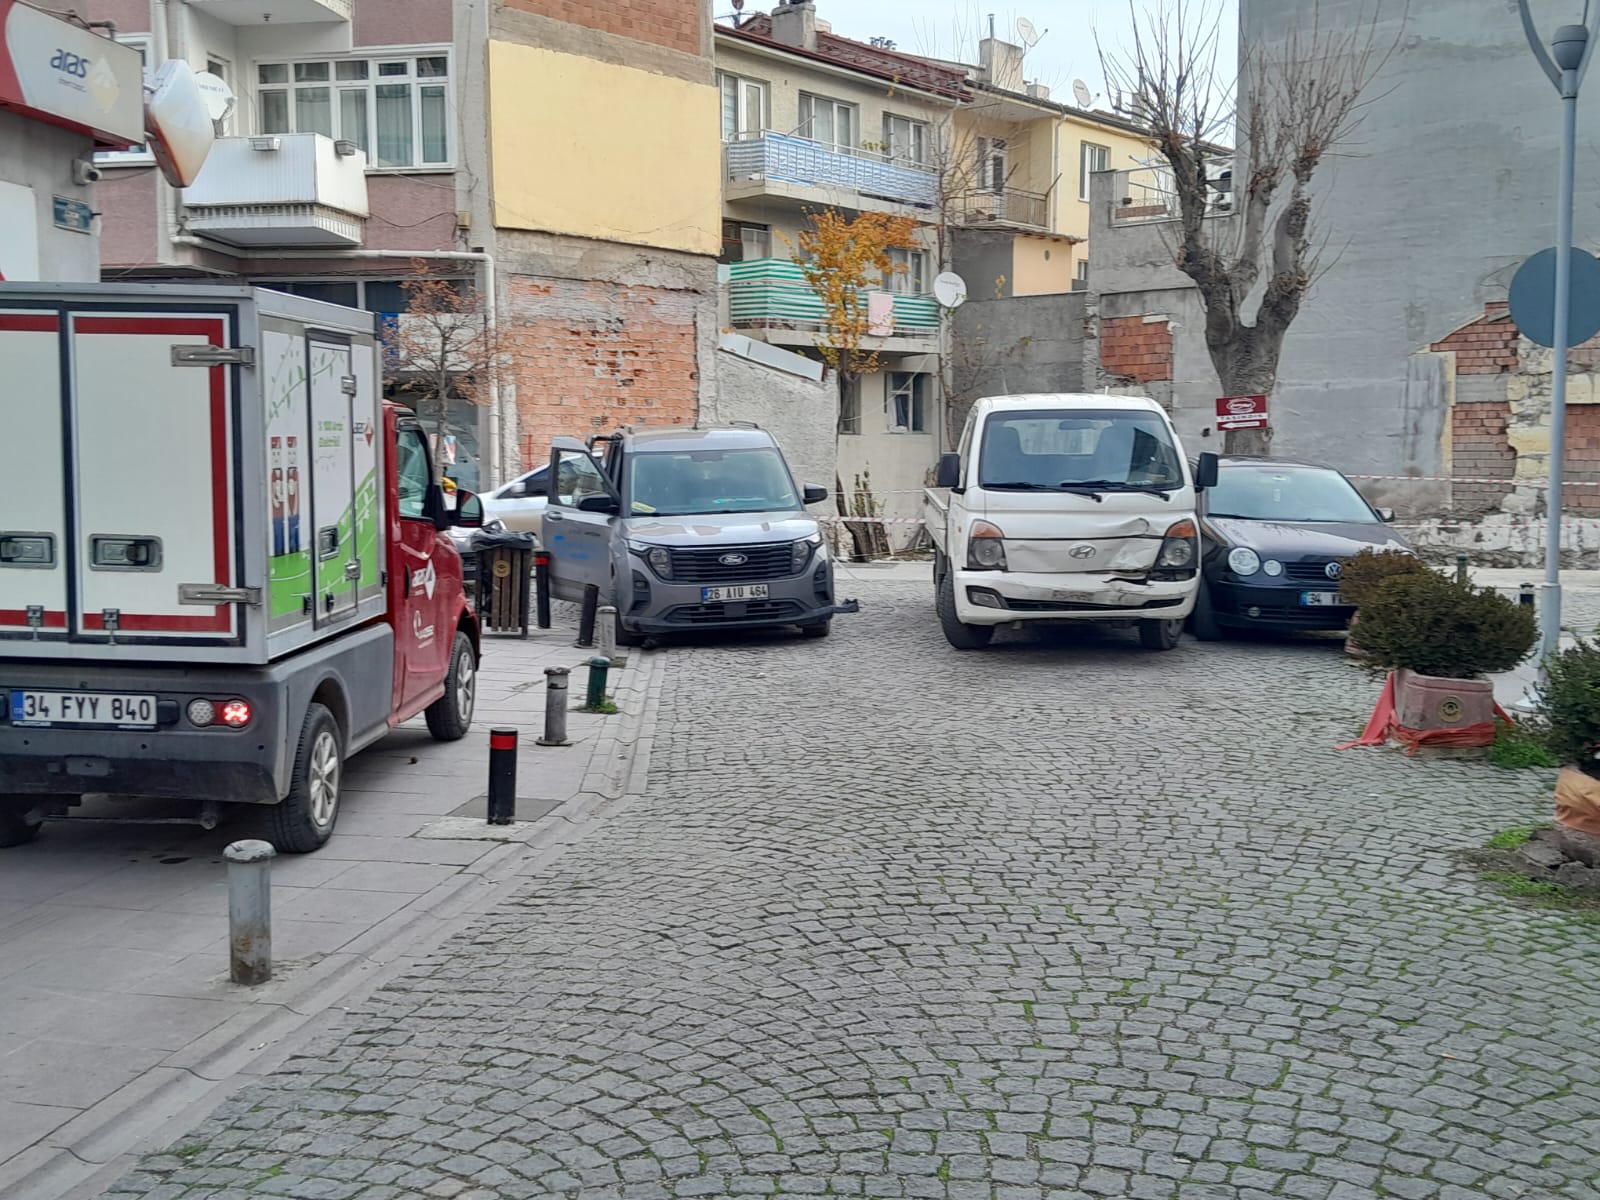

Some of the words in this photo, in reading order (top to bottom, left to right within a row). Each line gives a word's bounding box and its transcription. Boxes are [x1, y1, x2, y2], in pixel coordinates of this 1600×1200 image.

[51, 48, 91, 78] aras
[709, 589, 721, 600] 26
[1308, 593, 1321, 604] 34
[25, 694, 49, 718] 34
[61, 696, 100, 719] FYY
[111, 697, 150, 721] 840
